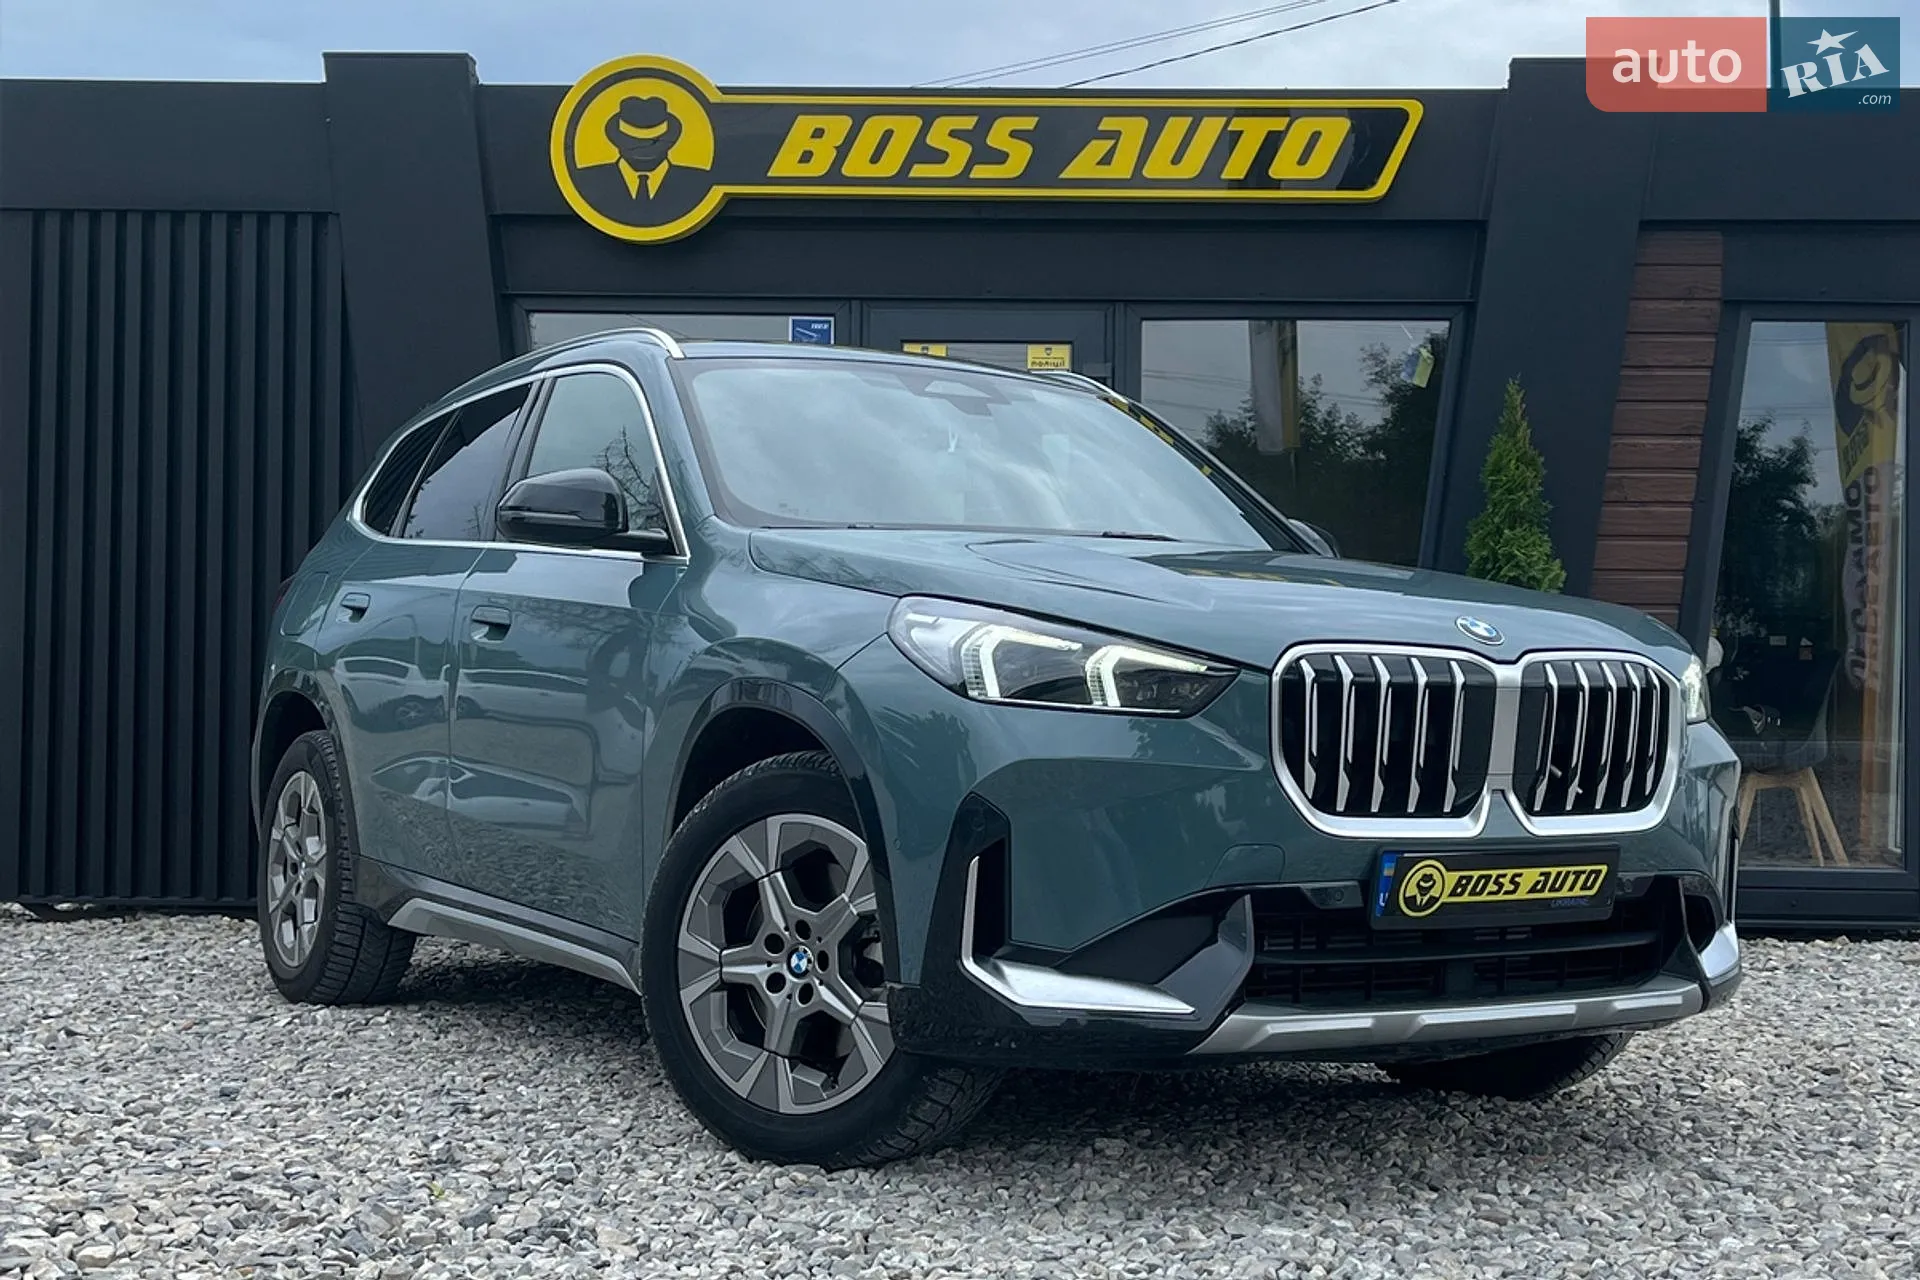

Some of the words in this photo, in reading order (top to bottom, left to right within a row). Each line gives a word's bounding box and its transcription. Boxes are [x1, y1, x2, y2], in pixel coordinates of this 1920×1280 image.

[767, 114, 1037, 179] BOSS
[1060, 115, 1351, 180] AUTO
[1447, 871, 1525, 897] BOSS
[1525, 868, 1603, 895] AUTO
